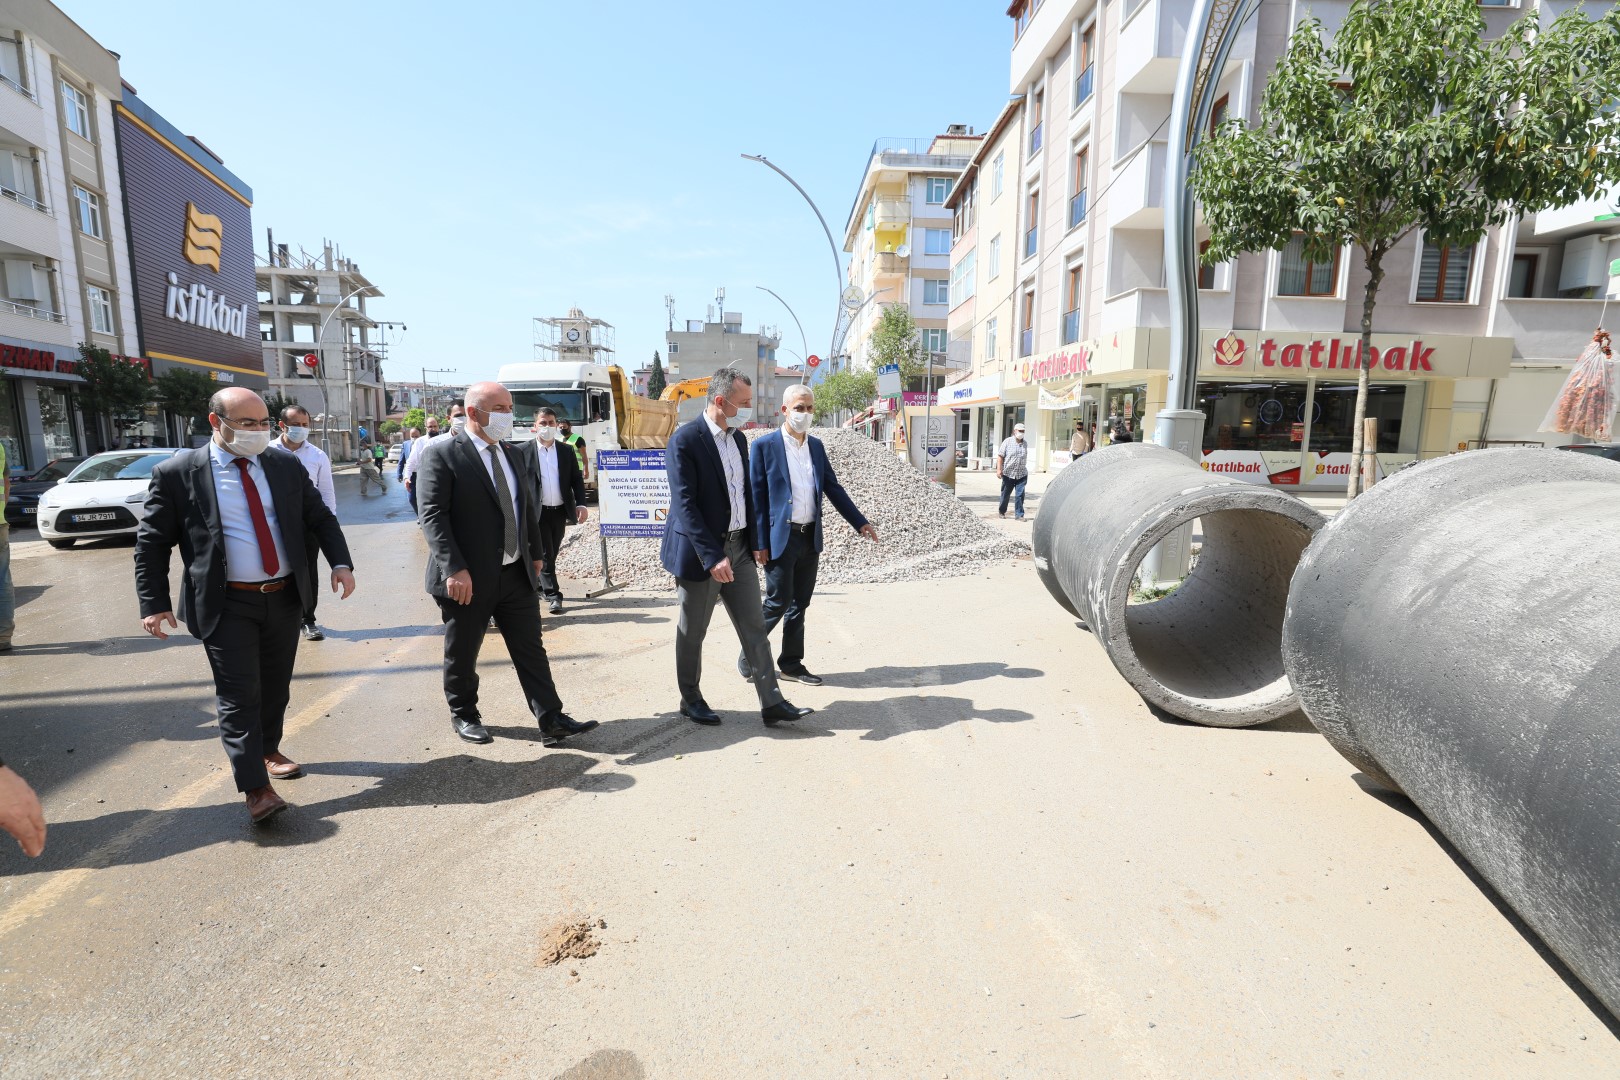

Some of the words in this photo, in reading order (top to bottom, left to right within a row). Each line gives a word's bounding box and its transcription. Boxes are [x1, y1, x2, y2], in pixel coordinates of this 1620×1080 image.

[166, 272, 248, 339] istikbal
[1260, 338, 1436, 371] tatlıbak
[1210, 461, 1261, 473] tatlıbak
